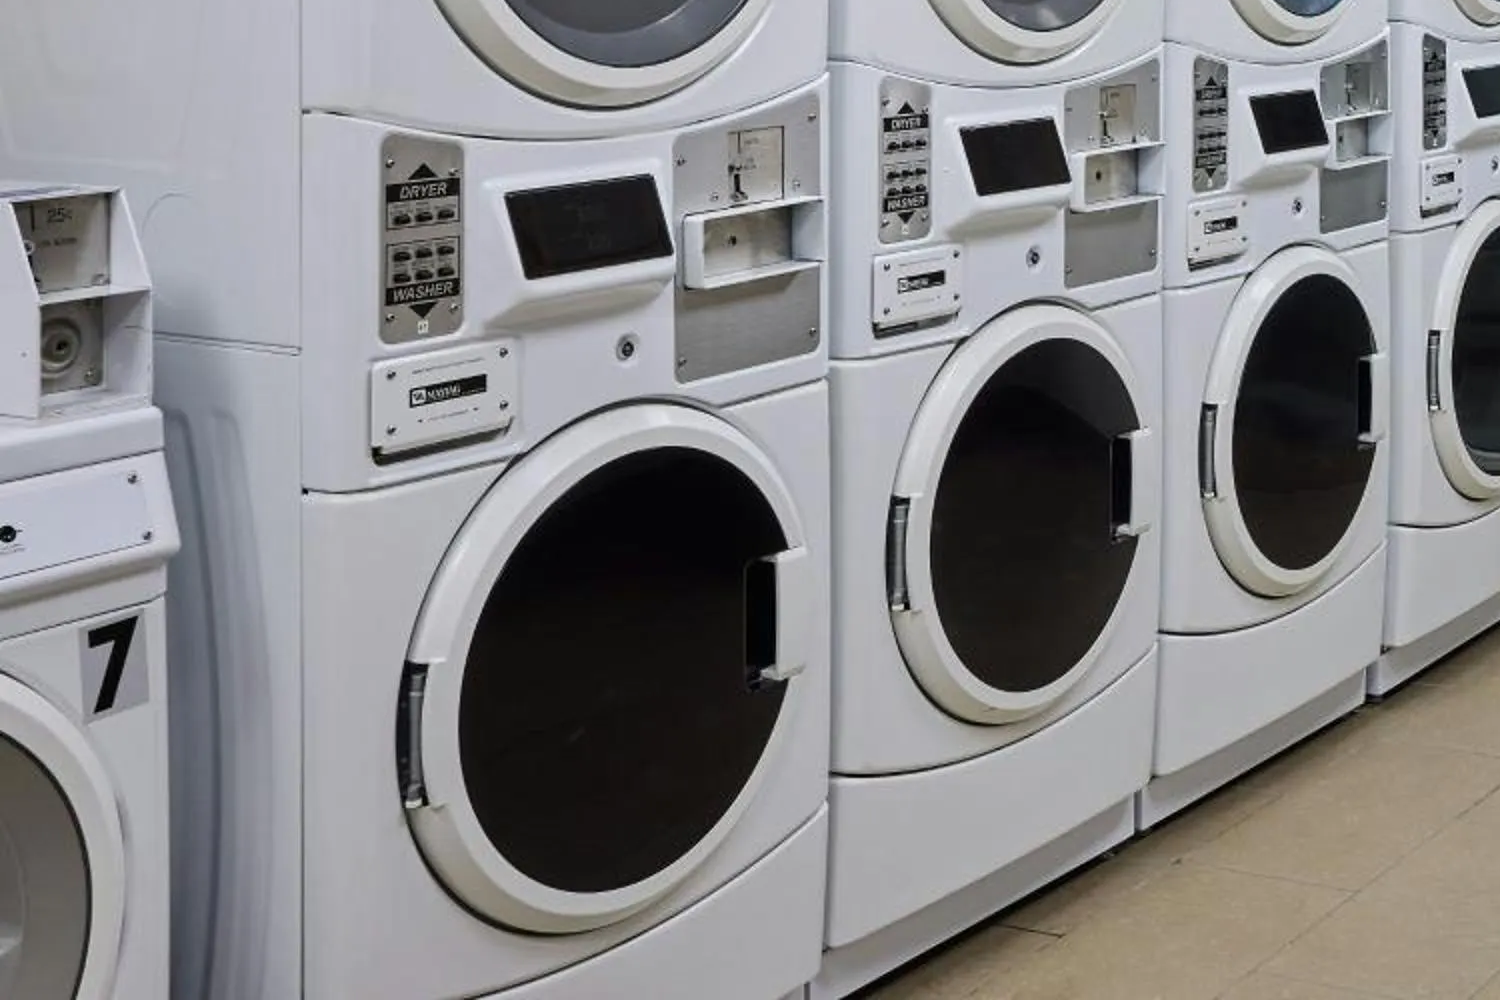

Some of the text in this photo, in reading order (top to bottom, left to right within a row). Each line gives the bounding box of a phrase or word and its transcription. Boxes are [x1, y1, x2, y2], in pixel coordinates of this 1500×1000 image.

[400, 182, 447, 199] DRYER
[393, 281, 453, 301] WASHER
[87, 615, 139, 715] 7
